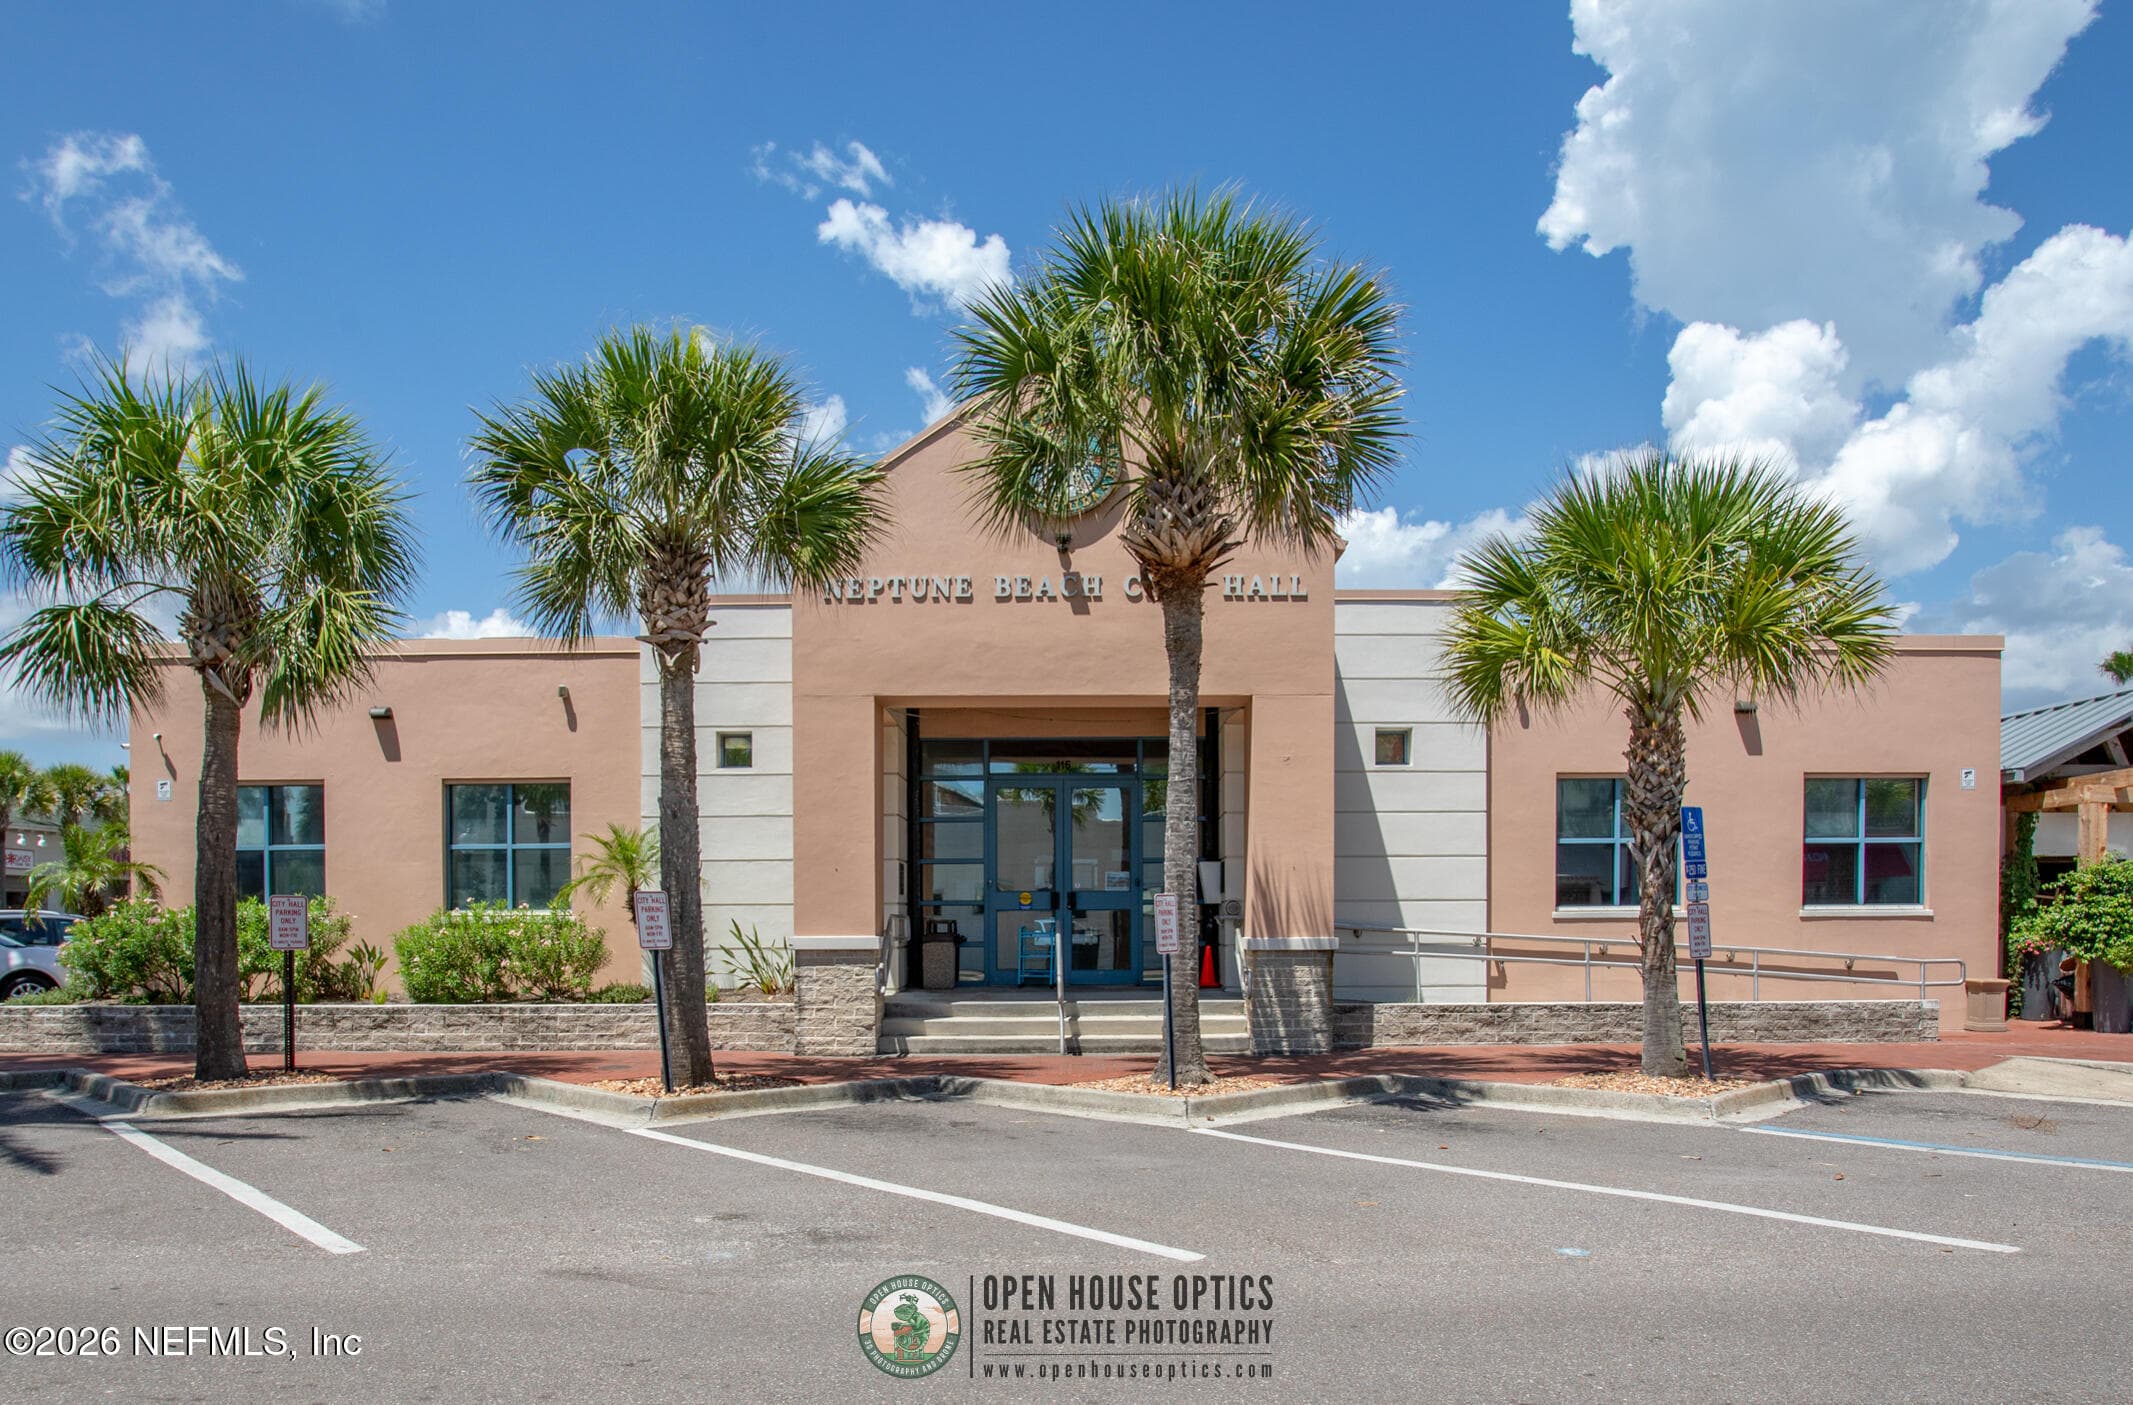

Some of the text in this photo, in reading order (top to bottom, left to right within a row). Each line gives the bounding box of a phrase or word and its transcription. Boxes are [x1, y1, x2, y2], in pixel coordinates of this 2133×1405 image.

[824, 575, 973, 599] NEPTUNE
[994, 575, 1103, 598] BEACH
[1223, 574, 1309, 597] HALL
[638, 896, 649, 904] CITY
